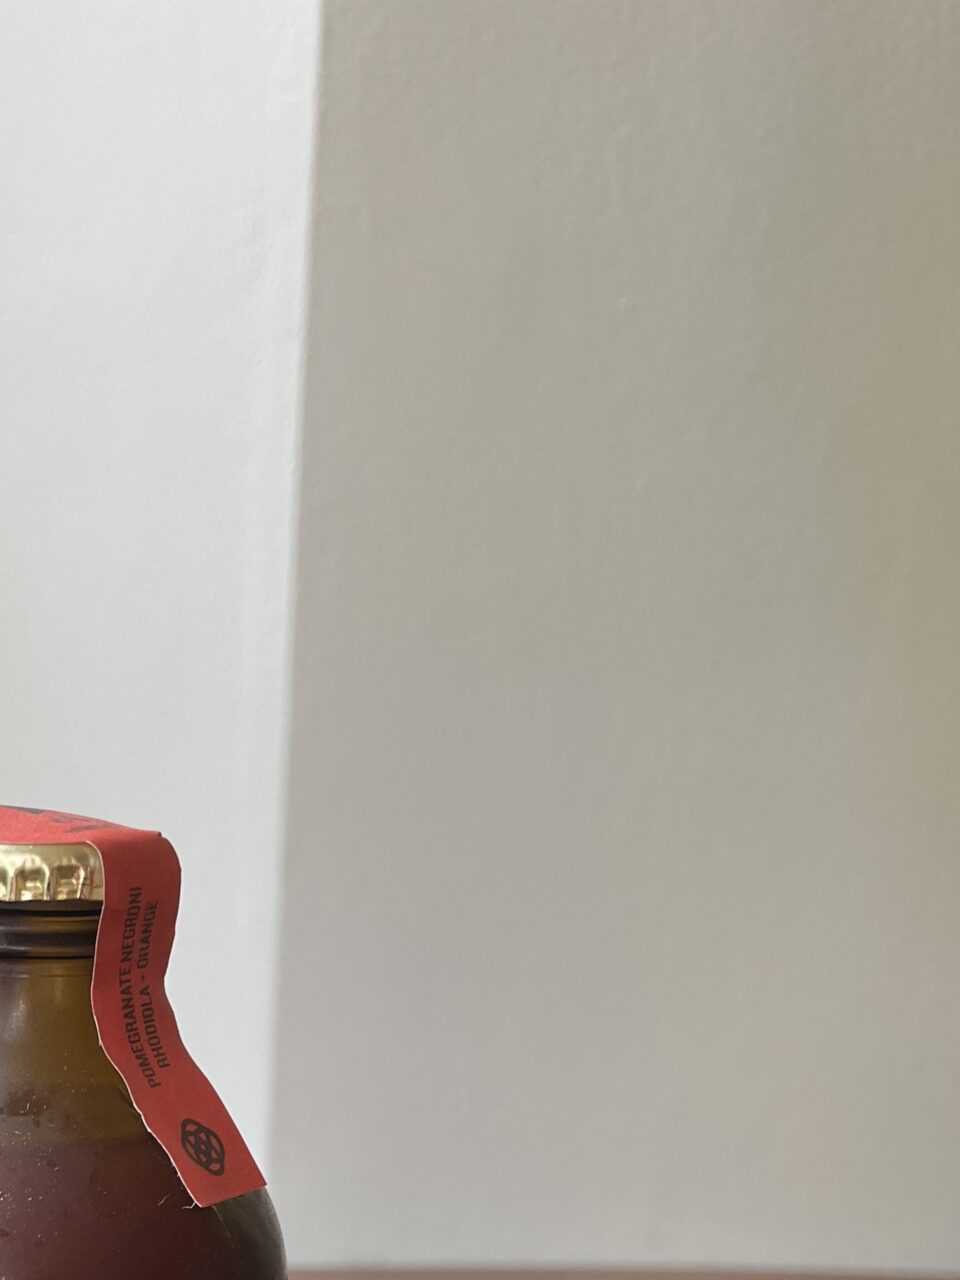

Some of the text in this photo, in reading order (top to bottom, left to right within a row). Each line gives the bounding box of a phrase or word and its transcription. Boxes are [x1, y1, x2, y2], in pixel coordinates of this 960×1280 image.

[137, 898, 158, 970] ORANGE
[119, 886, 161, 1089] POMEGRANATE NEGRONI
[140, 985, 170, 1069] RHODIOLA
